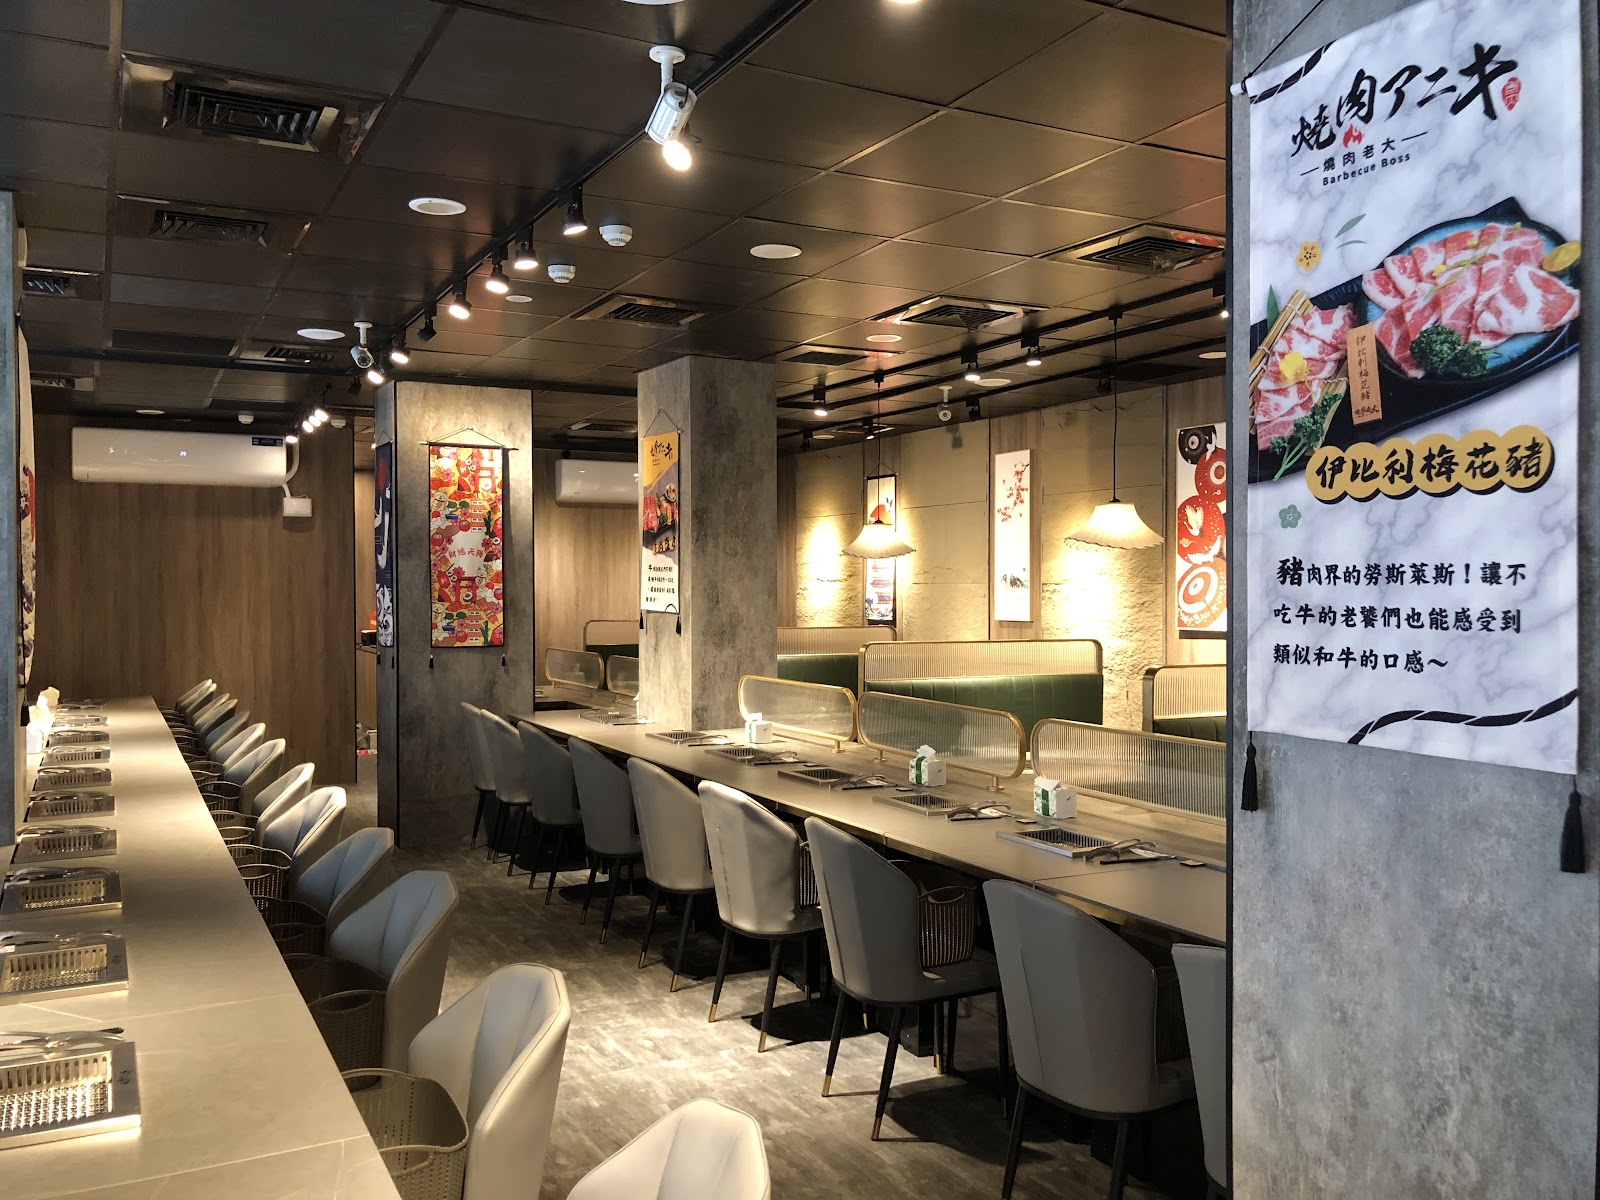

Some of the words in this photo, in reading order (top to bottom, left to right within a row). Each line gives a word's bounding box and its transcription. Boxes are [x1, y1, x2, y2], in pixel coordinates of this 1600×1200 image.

[1322, 163, 1376, 187] Barbecue
[1381, 153, 1411, 169] Boss
[1323, 137, 1396, 173] 燒肉老大
[1356, 335, 1371, 401] 伊比利梅花豬
[1315, 437, 1545, 490] 伊比利梅花豬
[1273, 604, 1522, 634] 吃牛的老饕們也能感受到
